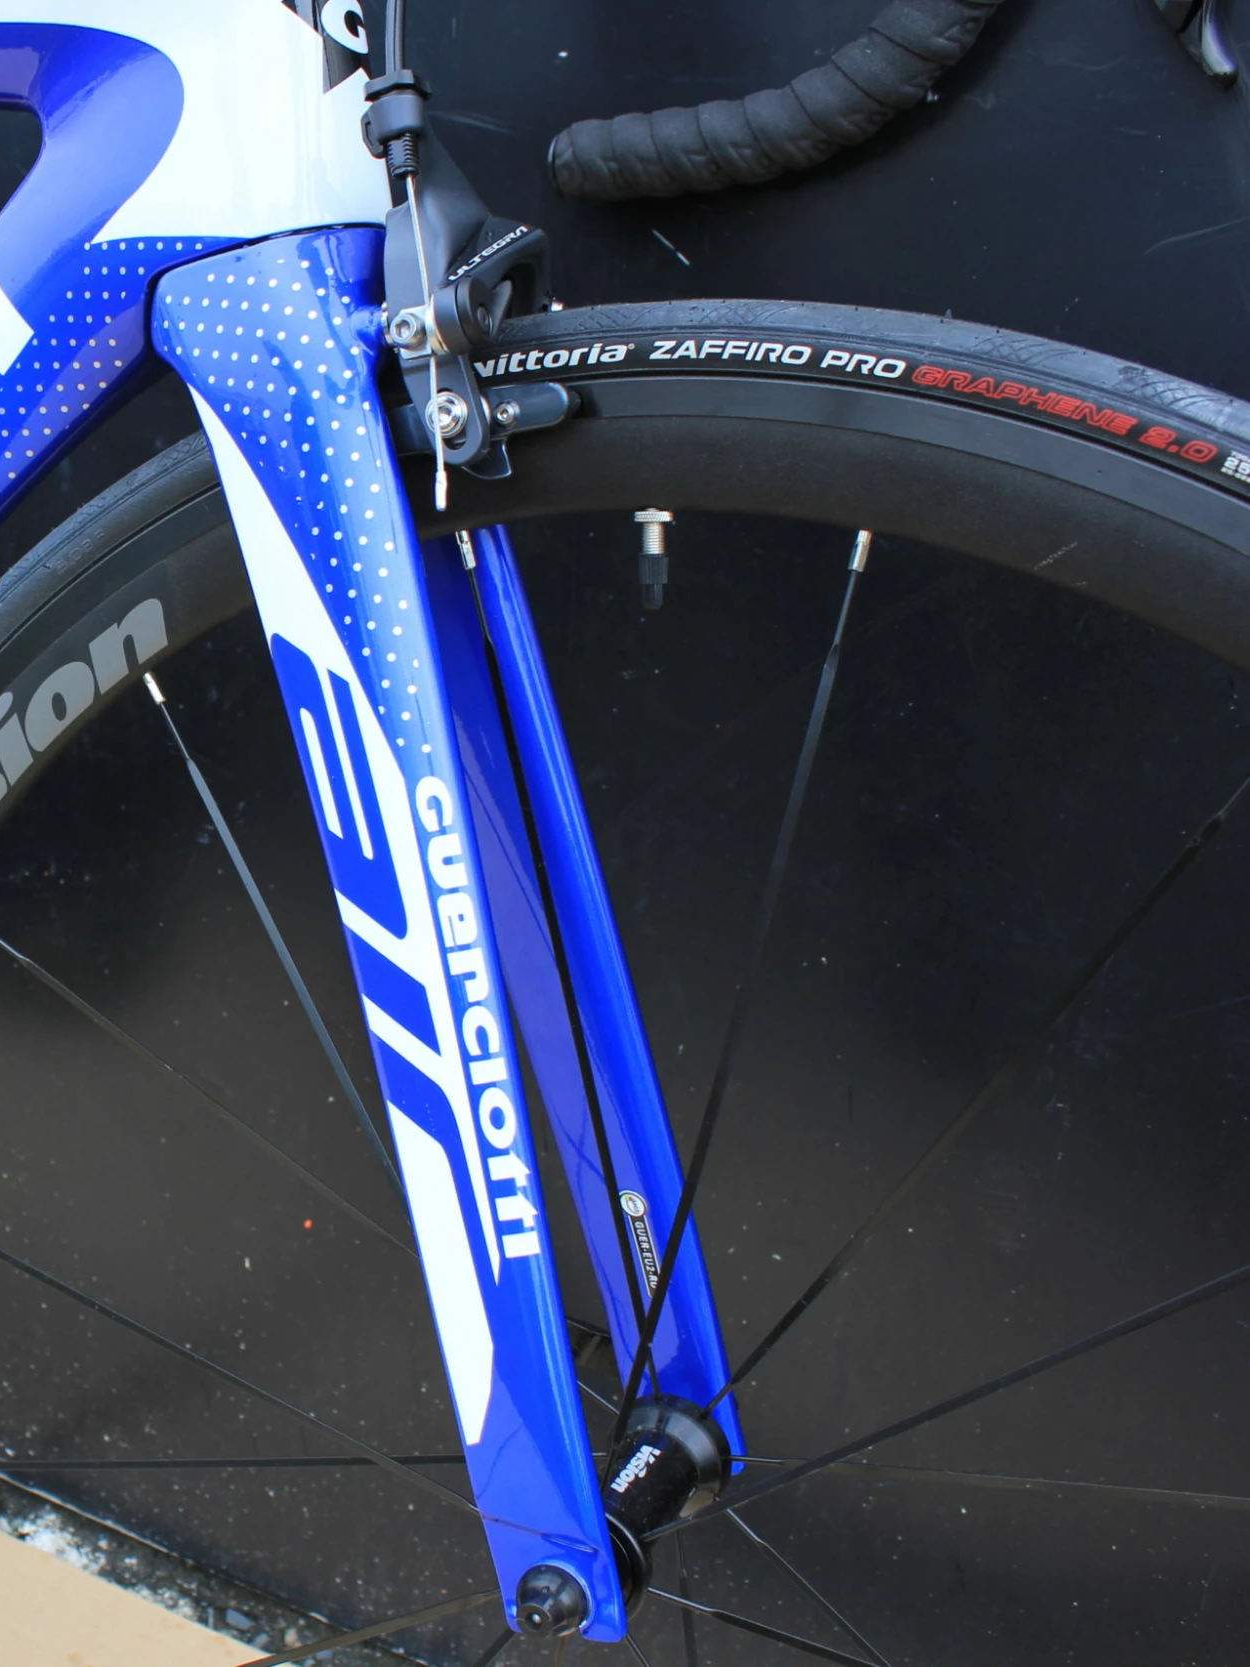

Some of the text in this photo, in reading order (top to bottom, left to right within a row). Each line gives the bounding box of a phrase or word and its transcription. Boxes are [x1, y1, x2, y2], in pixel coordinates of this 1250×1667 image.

[448, 225, 528, 281] ULTEGRA
[649, 339, 812, 366] ZAFFIRO
[820, 350, 908, 379] PRO
[911, 365, 1140, 436] GRAPHENE
[1138, 426, 1218, 463] 2.0
